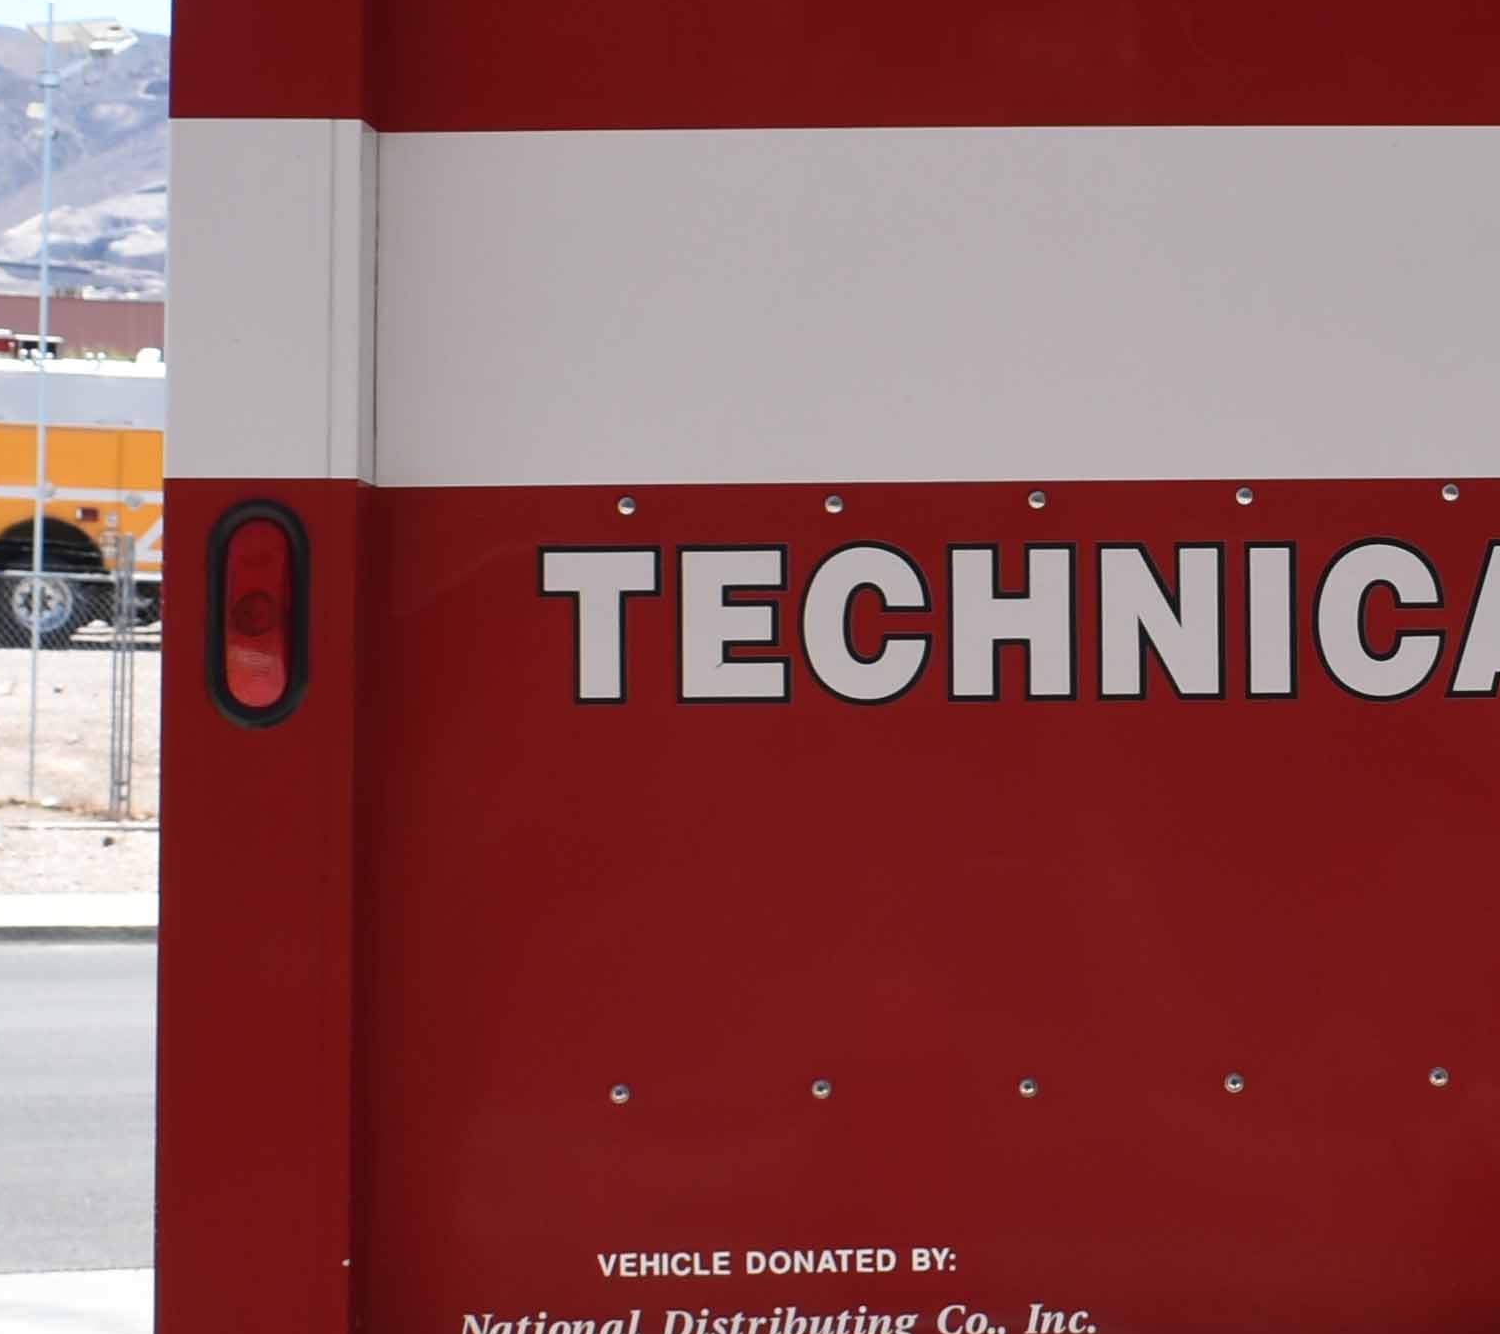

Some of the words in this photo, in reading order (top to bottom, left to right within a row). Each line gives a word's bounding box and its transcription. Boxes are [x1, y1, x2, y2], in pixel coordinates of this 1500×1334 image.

[596, 1250, 732, 1278] VEHICLE
[745, 1248, 897, 1275] DONATED
[911, 1247, 957, 1272] BY:
[1024, 1303, 1098, 1334] Inc.
